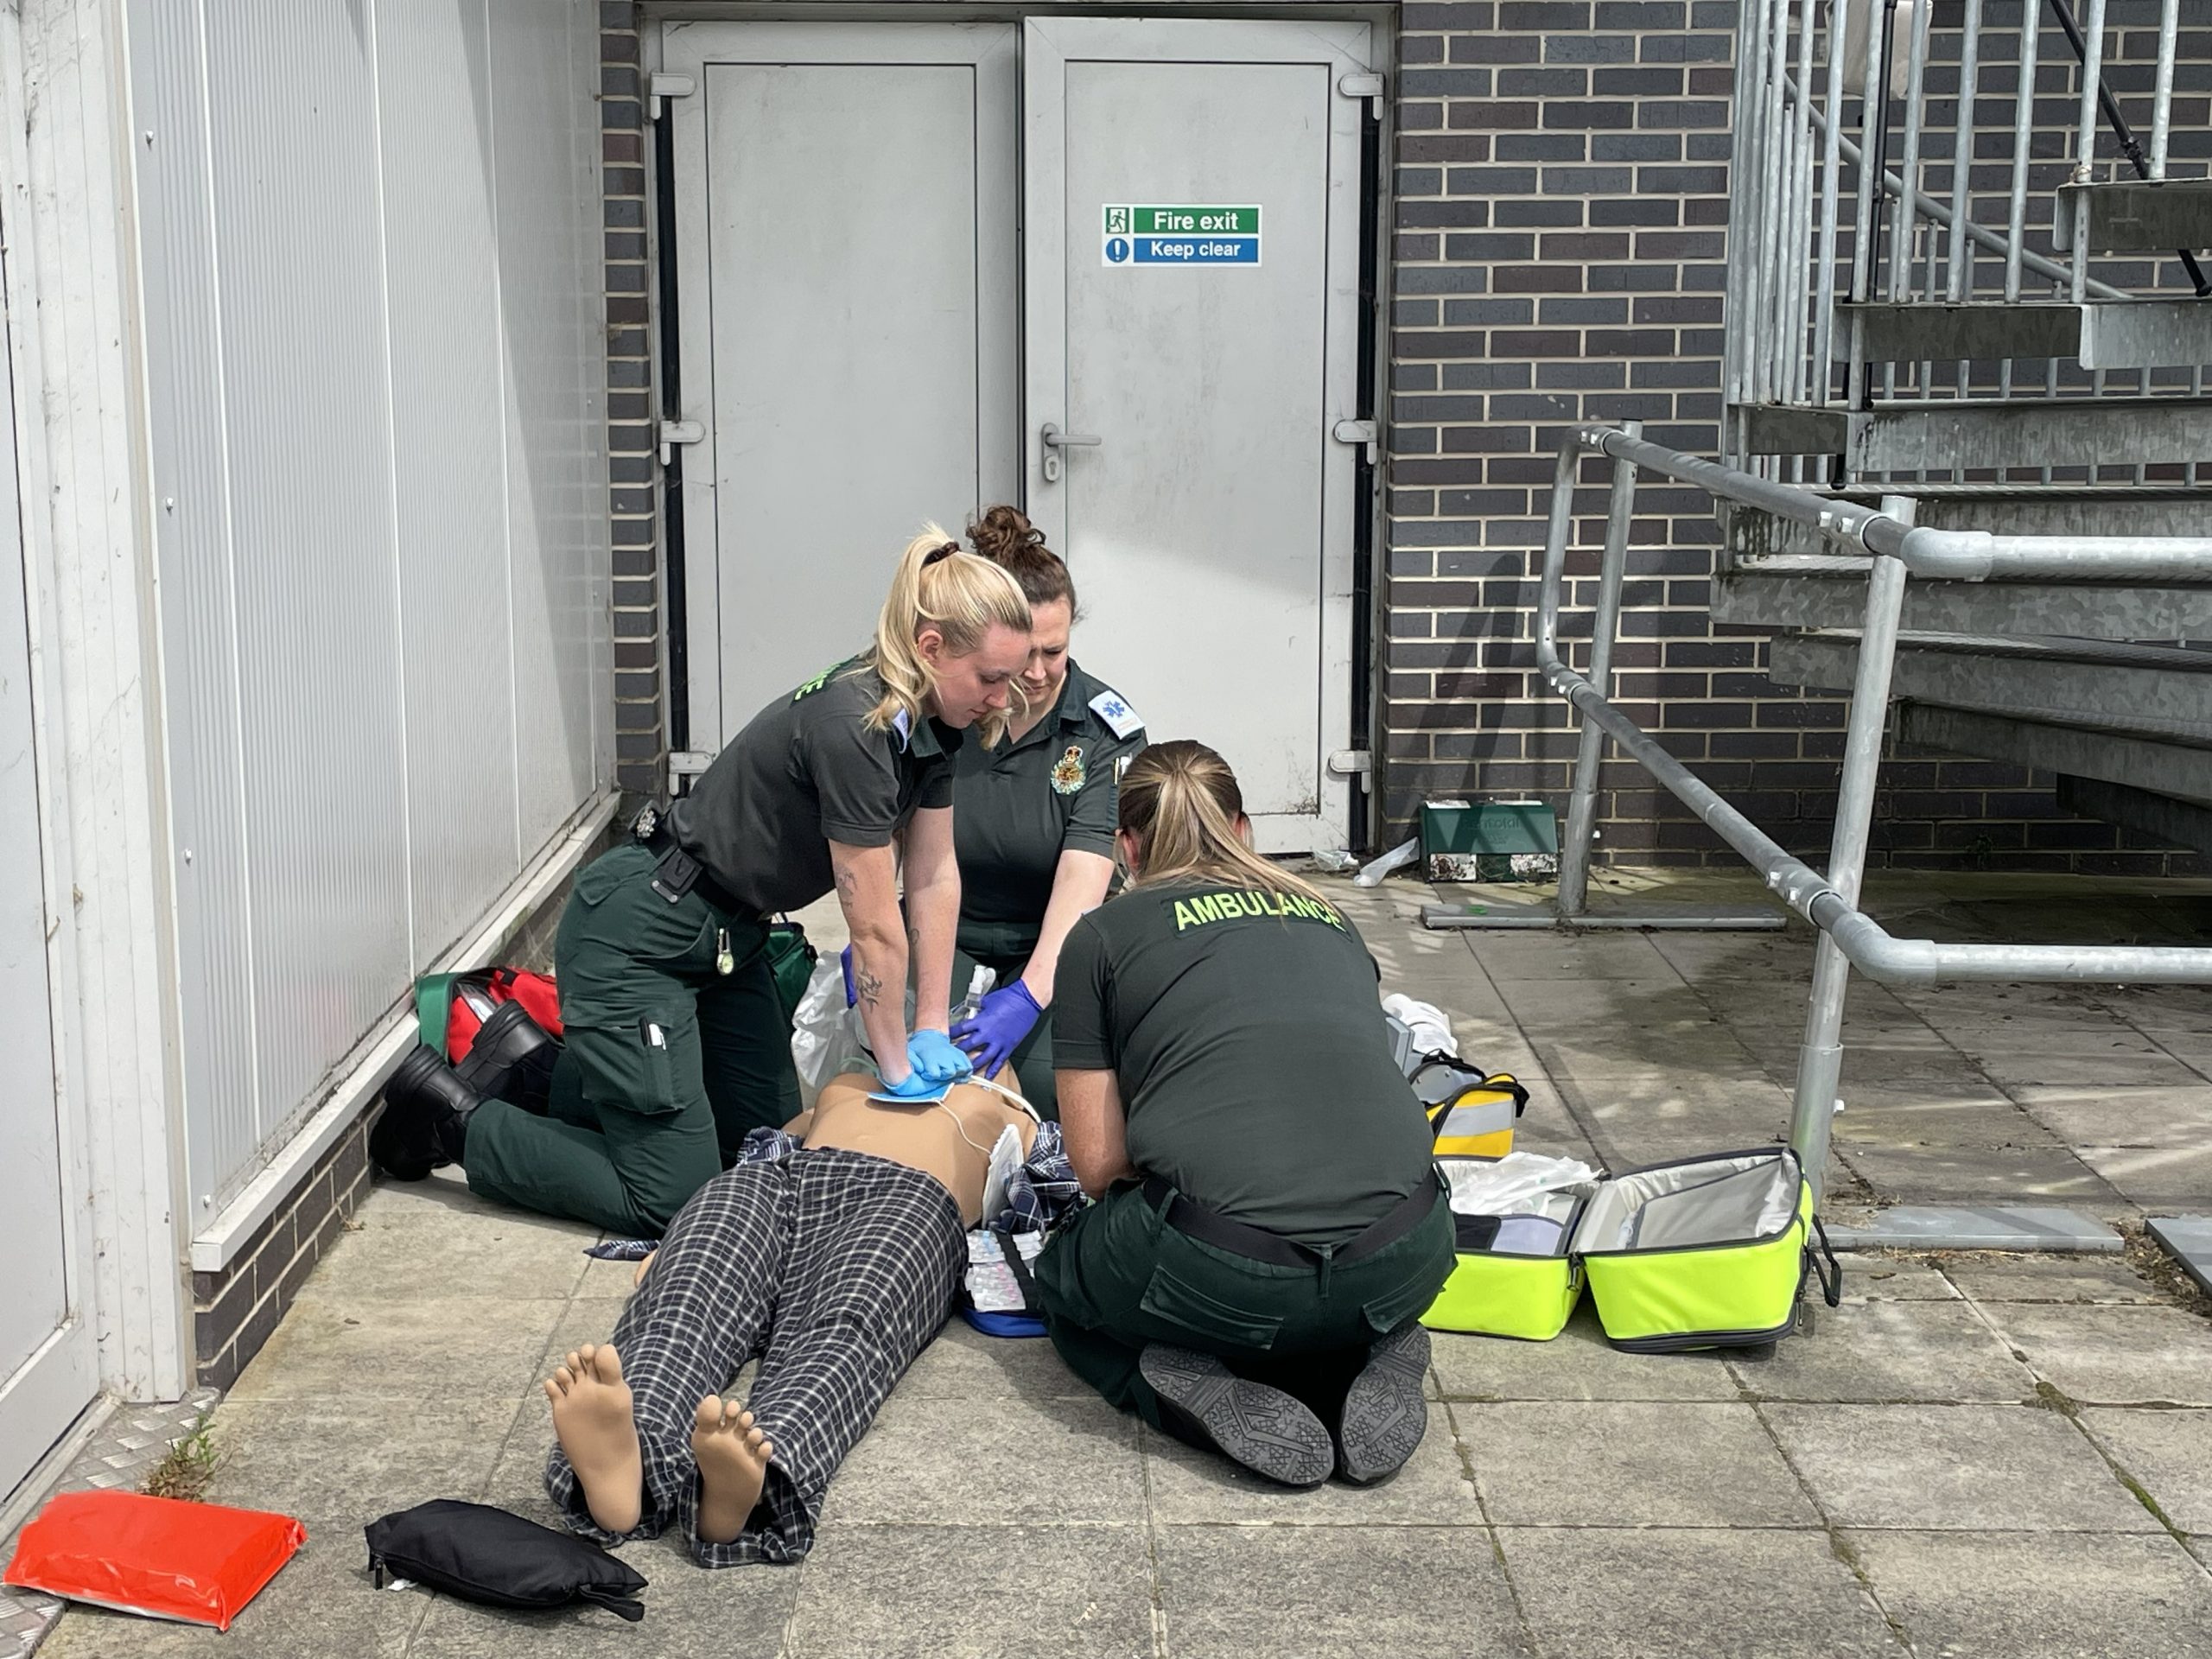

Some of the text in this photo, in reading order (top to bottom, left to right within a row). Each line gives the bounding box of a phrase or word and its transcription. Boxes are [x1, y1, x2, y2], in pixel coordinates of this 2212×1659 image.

[1154, 211, 1238, 230] Fire exit
[1151, 240, 1241, 260] Keep clear
[1173, 891, 1346, 932] AMBULANCE
